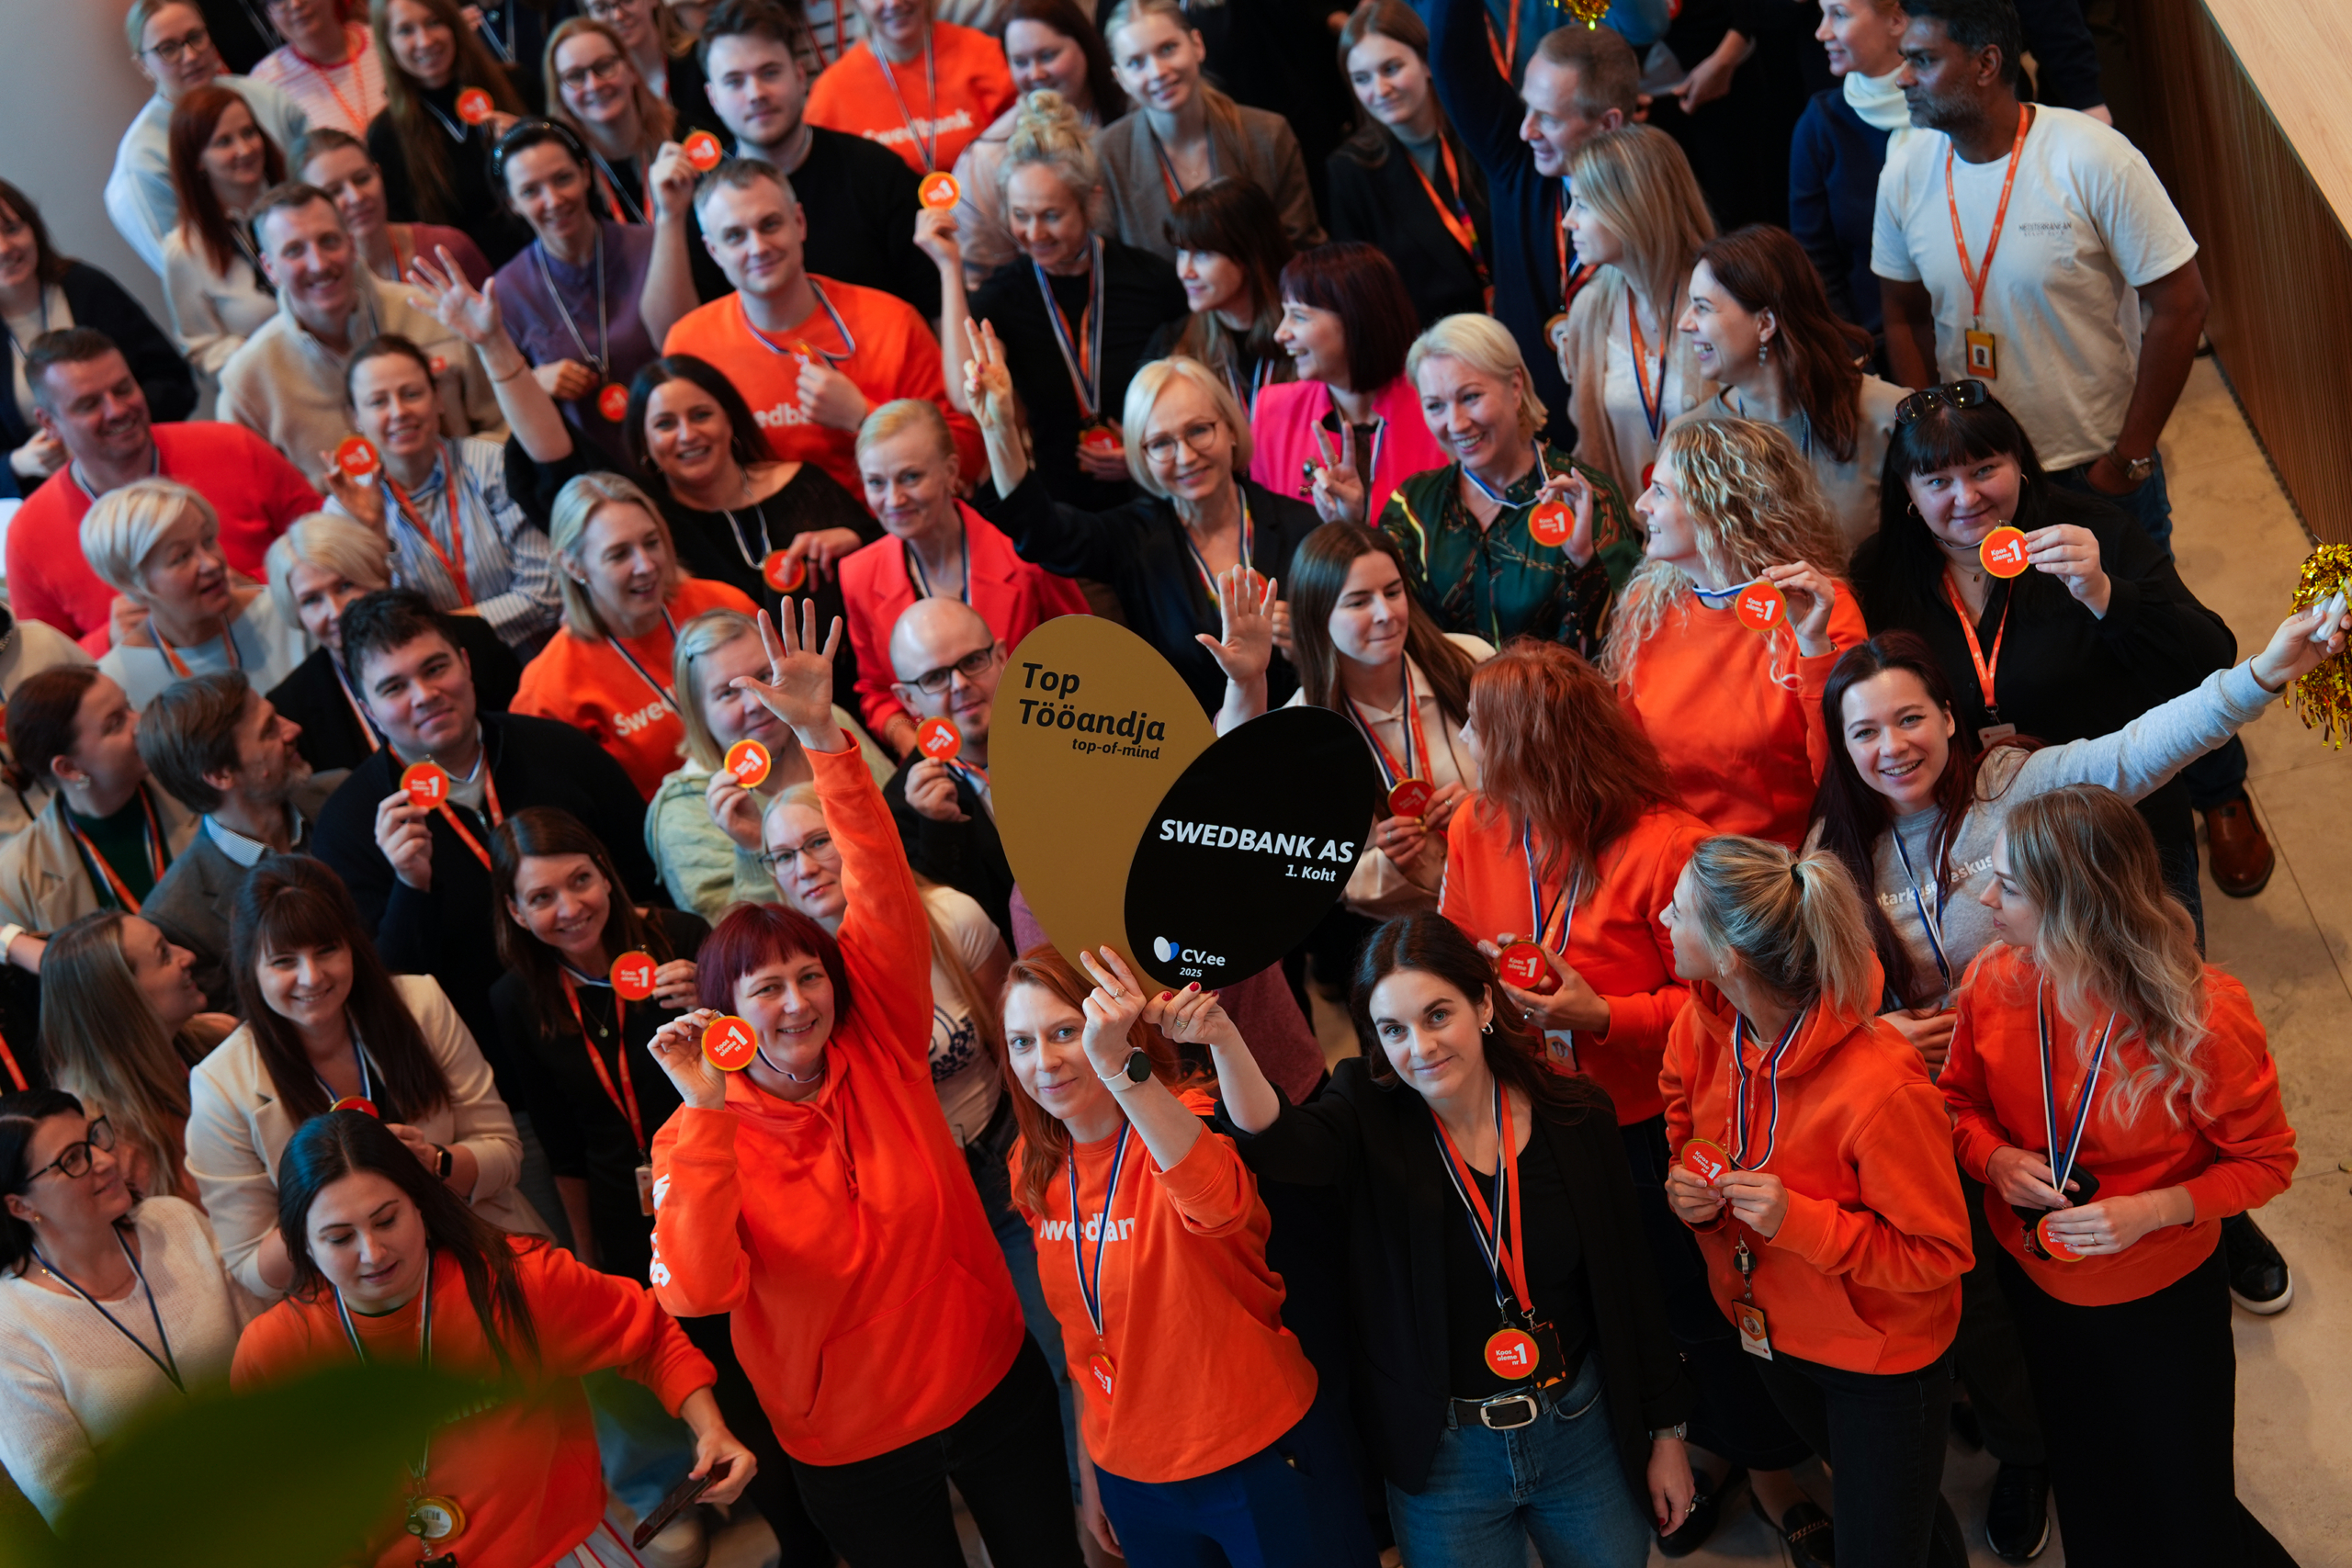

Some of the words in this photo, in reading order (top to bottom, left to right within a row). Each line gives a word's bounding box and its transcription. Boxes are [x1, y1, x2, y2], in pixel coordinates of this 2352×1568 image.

[1555, 512, 1566, 532] 1
[1991, 548, 2007, 557] Koos
[1992, 552, 2012, 561] oleme
[2007, 539, 2022, 561] 1
[1747, 597, 1762, 606] Koos
[1764, 600, 1776, 621] 1
[1023, 662, 1080, 700] Top
[1019, 699, 1165, 745] Tööandja
[935, 725, 954, 742] 1
[745, 748, 763, 767] 1
[1072, 739, 1160, 760] top-of-mind
[428, 776, 440, 796] 1
[1159, 819, 1316, 859] SWEDBANK
[1317, 840, 1354, 863] AS
[1285, 864, 1297, 877] 1.
[1301, 866, 1336, 882] Koht
[1951, 855, 1994, 884] eskus
[1182, 948, 1226, 966] CV.ee
[638, 966, 649, 987] 1
[1179, 967, 1203, 977] 2025
[1507, 963, 1527, 971] oleme
[1527, 957, 1537, 977] 1
[728, 1025, 748, 1046] 1
[714, 1039, 729, 1053] Koos
[719, 1041, 738, 1056] oleme
[1692, 1156, 1710, 1169] oleme
[1695, 1151, 1709, 1164] Koos
[1708, 1162, 1722, 1179] 1
[1514, 1343, 1527, 1364] 1
[1105, 1375, 1112, 1394] 1
